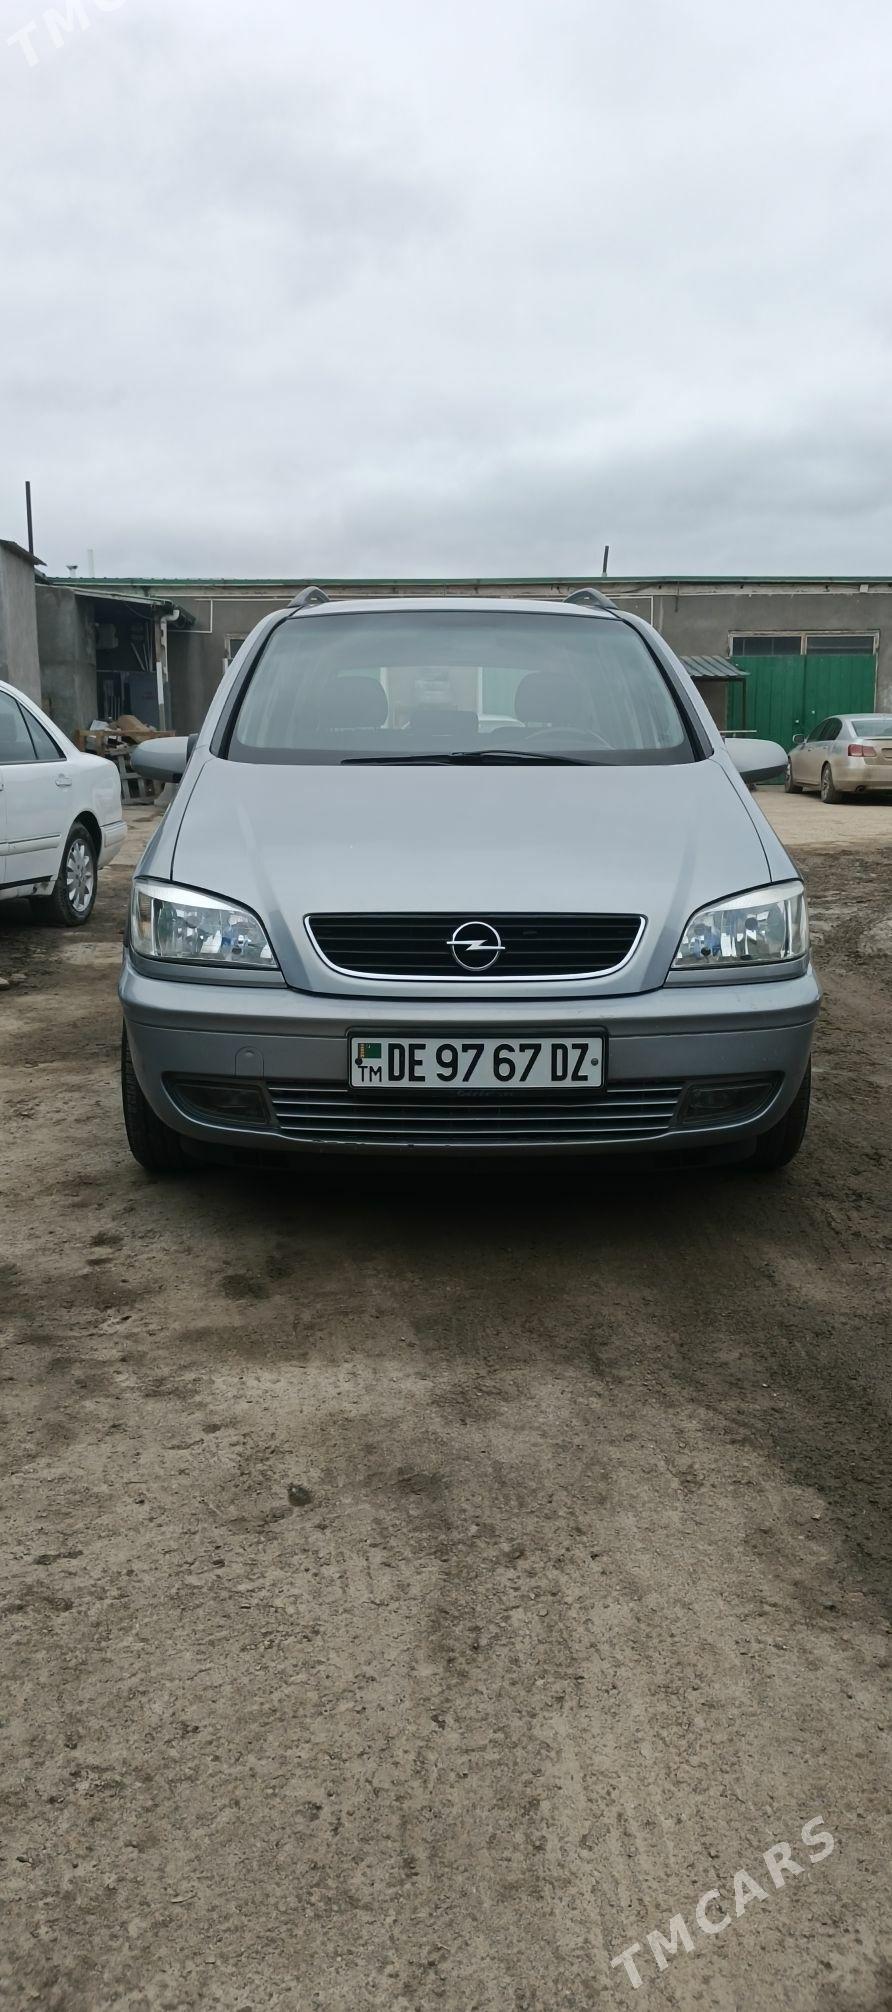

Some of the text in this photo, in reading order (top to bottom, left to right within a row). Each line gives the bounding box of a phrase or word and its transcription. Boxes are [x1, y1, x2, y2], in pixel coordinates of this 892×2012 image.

[357, 1065, 382, 1083] TM
[388, 1043, 589, 1082] DE 97 67 DZ
